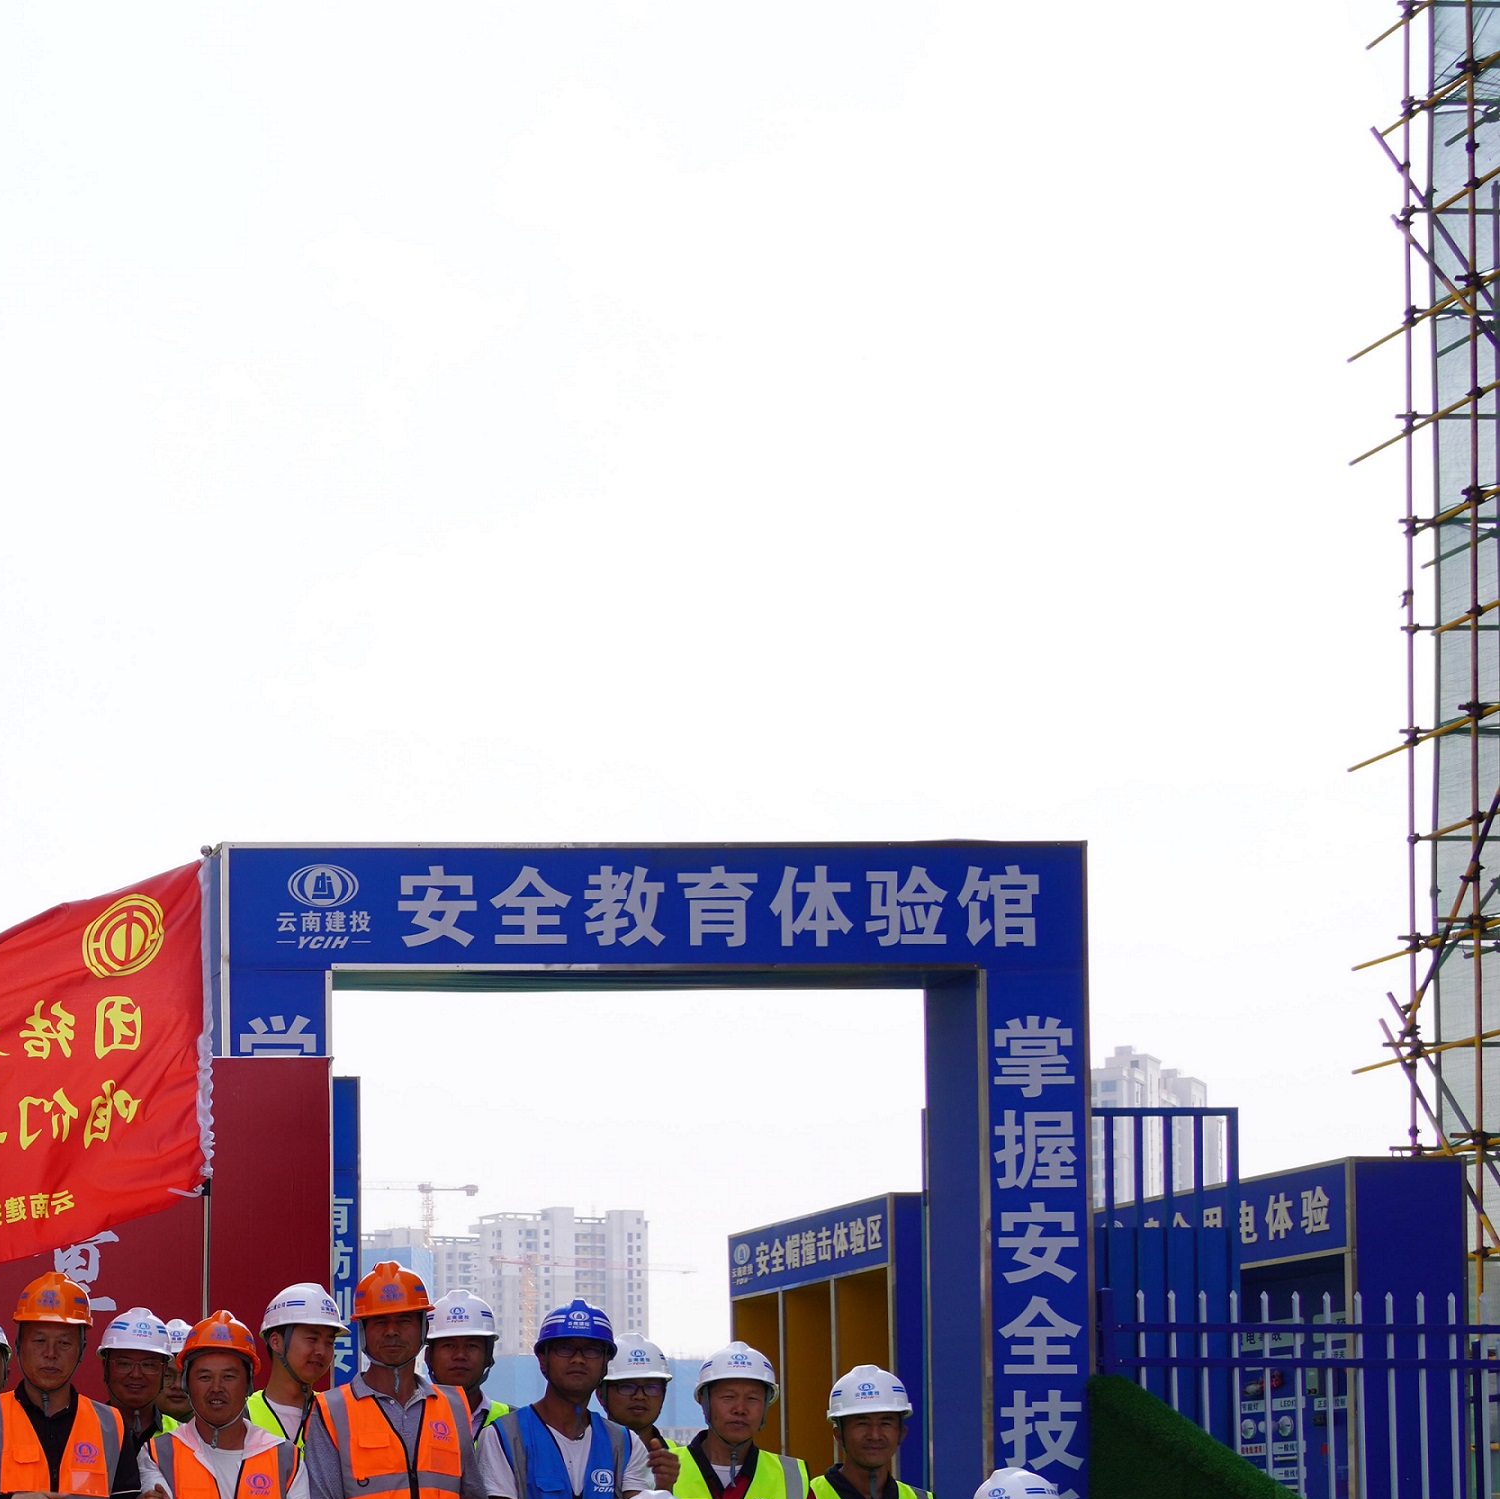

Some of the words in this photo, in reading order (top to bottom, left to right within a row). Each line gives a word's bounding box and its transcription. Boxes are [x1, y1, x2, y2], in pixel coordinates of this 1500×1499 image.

[276, 909, 372, 934] 云南建投
[397, 866, 1042, 948] 安全教育体验馆
[298, 936, 349, 948] YCIH
[753, 1214, 883, 1277] 安全帽撞击体验区
